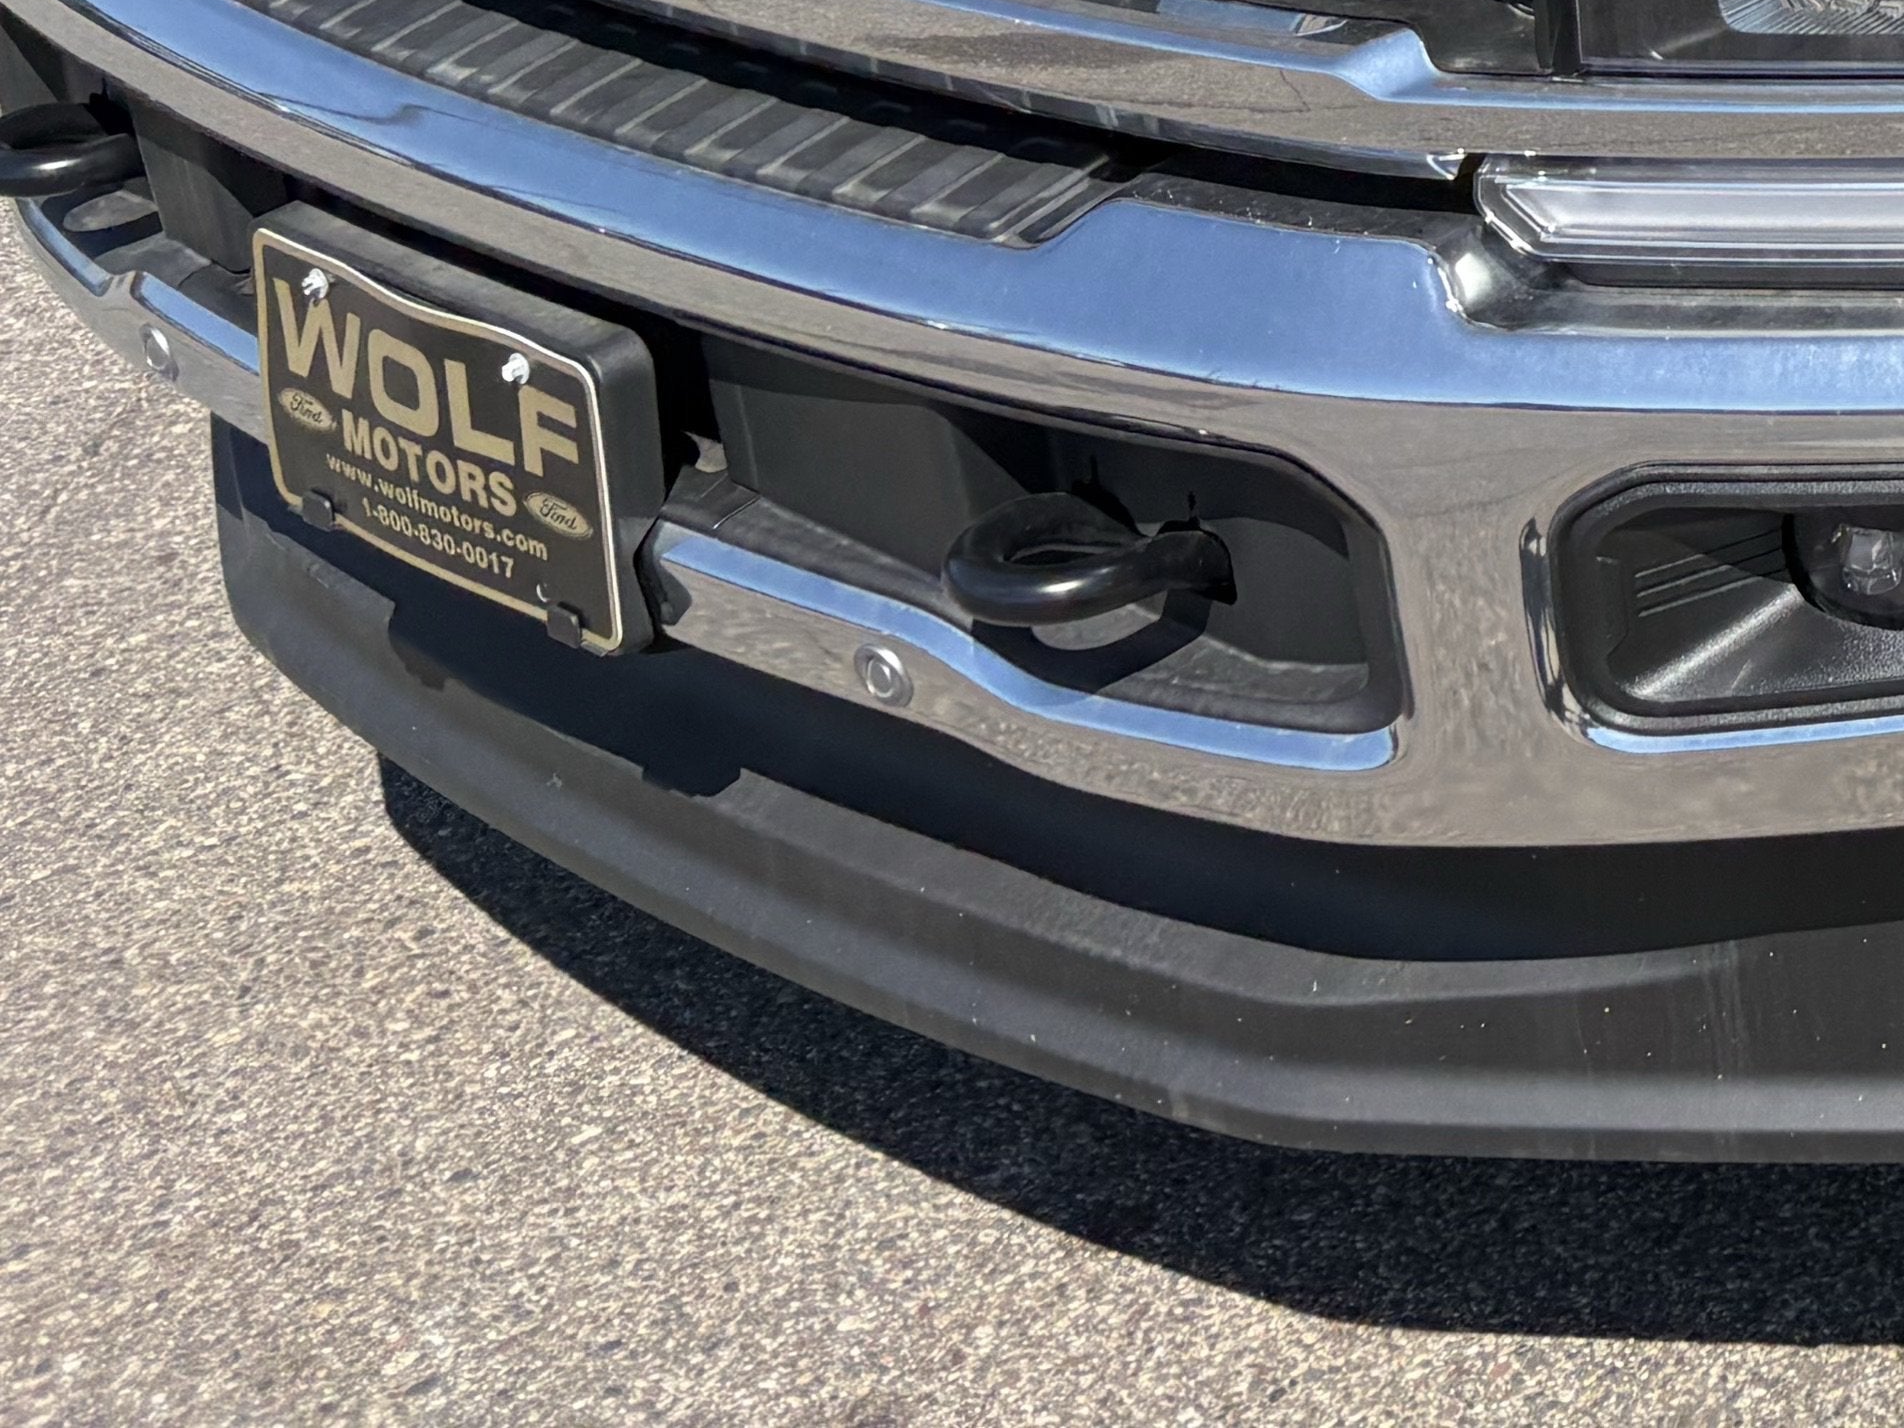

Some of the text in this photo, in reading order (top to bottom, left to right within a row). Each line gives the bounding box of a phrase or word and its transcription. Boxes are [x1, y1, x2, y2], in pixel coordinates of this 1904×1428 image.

[273, 276, 580, 478] WOLF
[326, 453, 549, 561] www.wolfmotors.com
[341, 409, 518, 518] MOTORS
[361, 499, 515, 579] 1-800-830-0017
